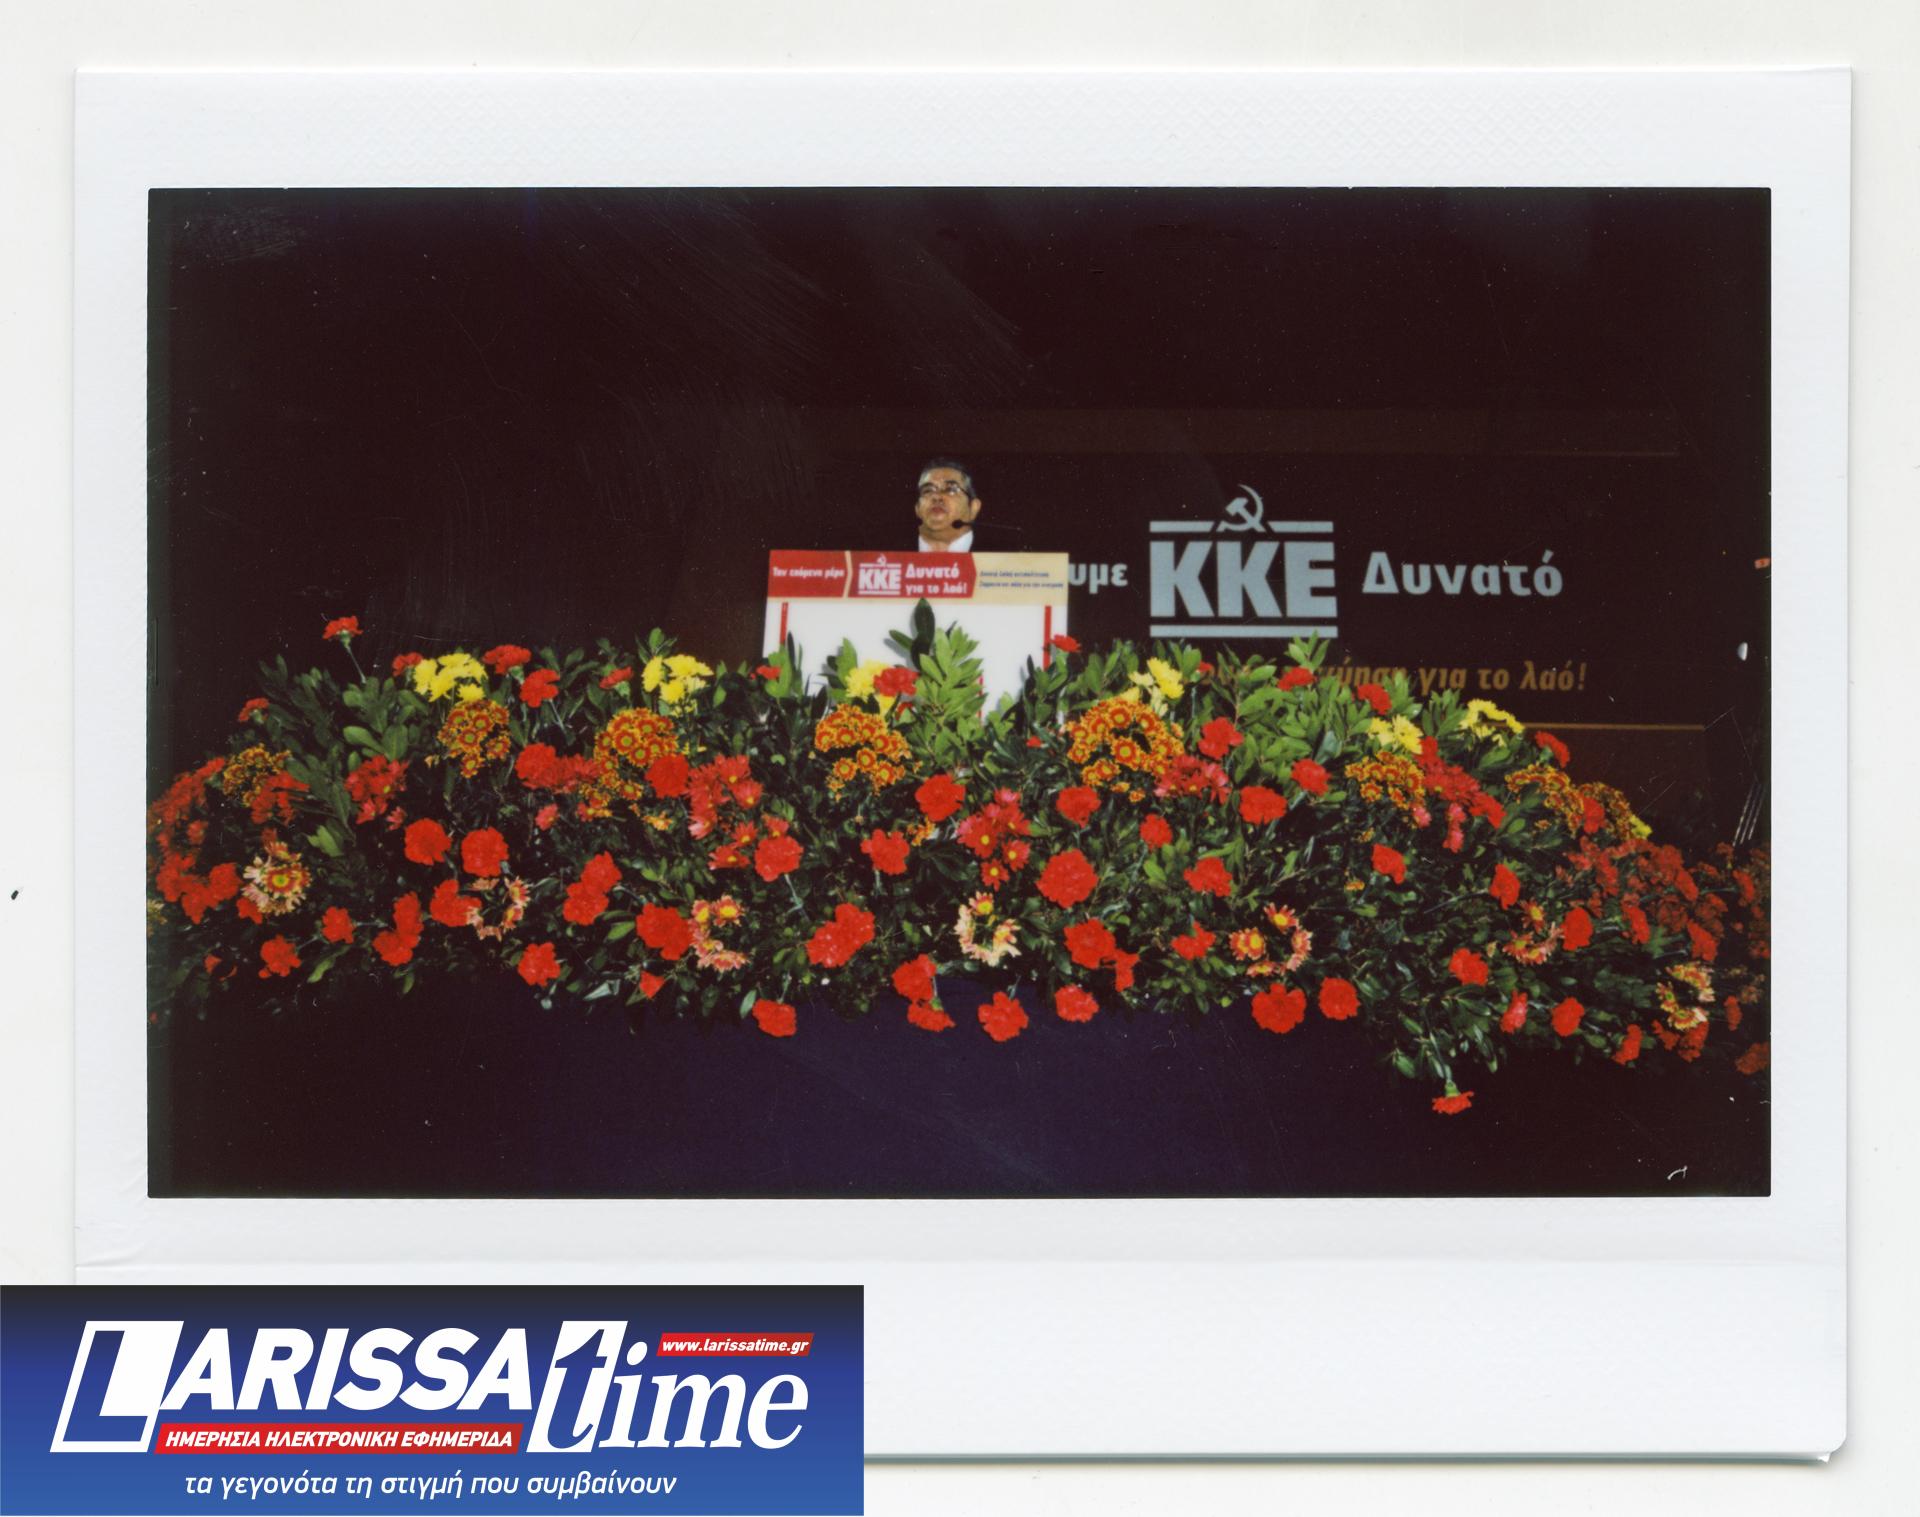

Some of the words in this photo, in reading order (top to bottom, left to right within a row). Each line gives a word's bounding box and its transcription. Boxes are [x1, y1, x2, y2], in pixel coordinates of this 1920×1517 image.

[905, 562, 960, 579] Δυνατό
[1362, 550, 1563, 597] Δυνατό
[905, 584, 924, 596] για
[927, 585, 940, 594] το
[943, 581, 968, 595] λαό!
[1418, 666, 1468, 697] για
[1477, 667, 1510, 691] το
[1520, 659, 1588, 691] λαό!
